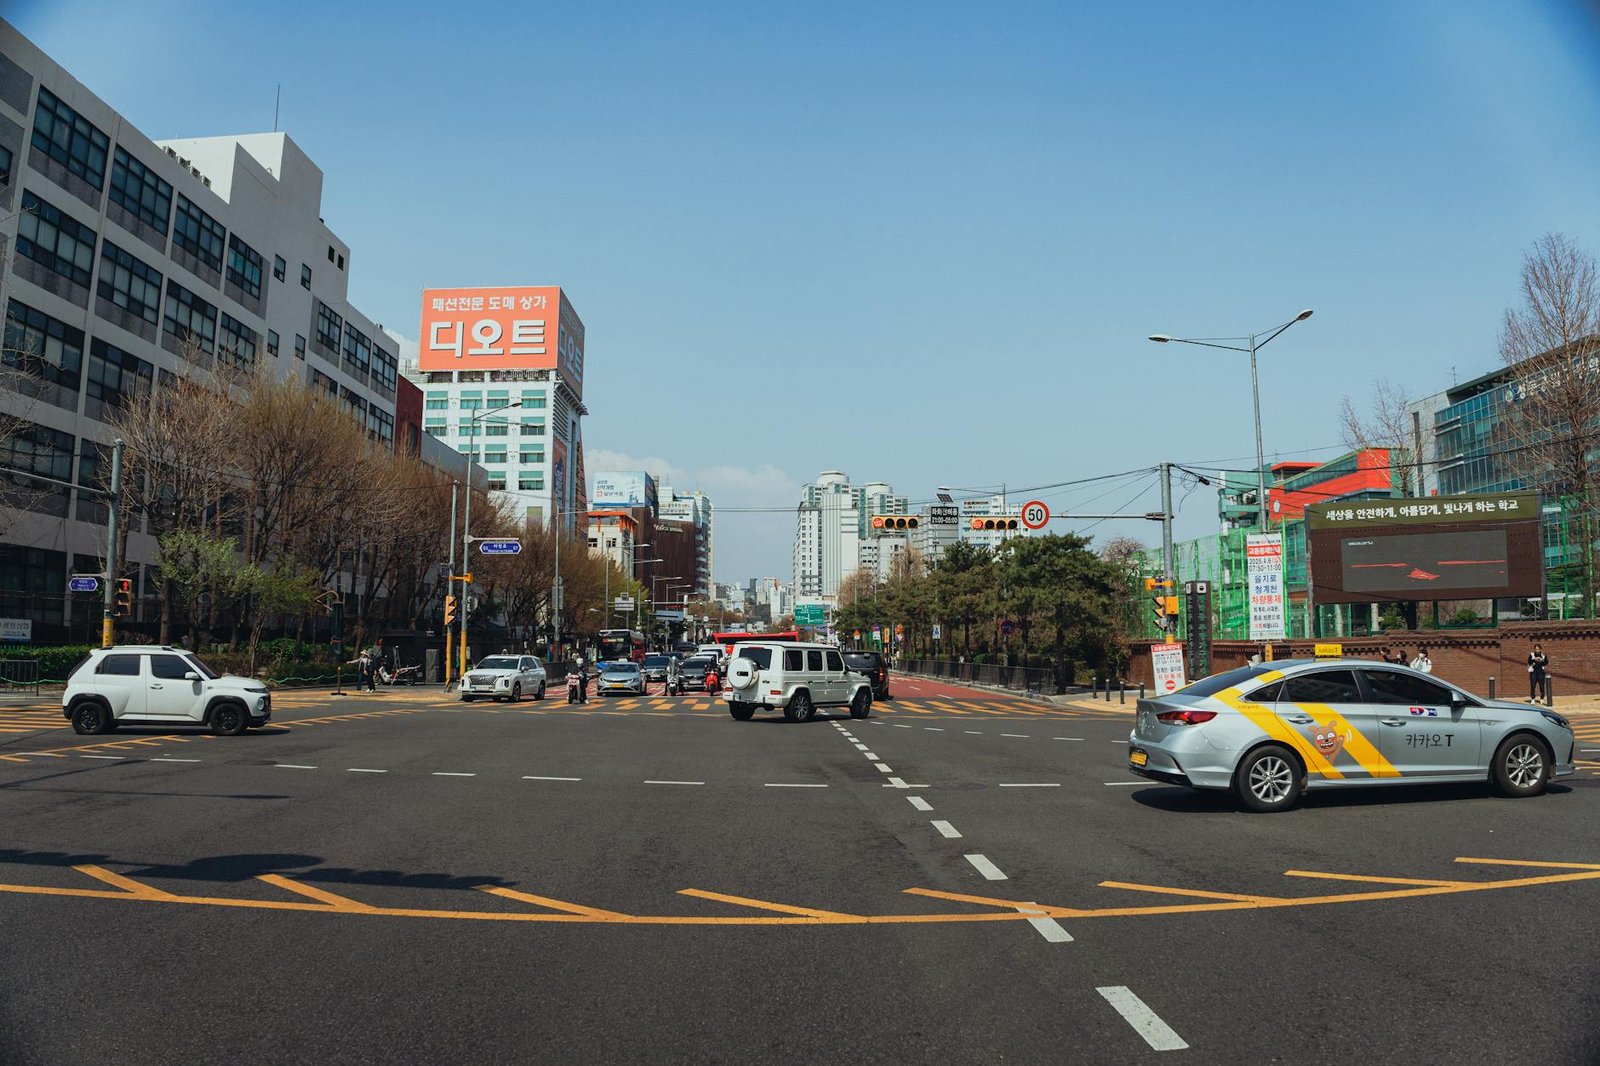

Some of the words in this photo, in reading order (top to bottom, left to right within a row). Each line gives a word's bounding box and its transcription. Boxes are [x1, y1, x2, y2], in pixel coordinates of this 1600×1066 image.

[432, 297, 484, 311] 패션전문
[488, 296, 515, 310] 도매
[519, 295, 547, 310] 상가
[430, 319, 546, 358] 디오트
[1028, 508, 1042, 524] 50
[1326, 509, 1354, 522] 세상을
[1356, 507, 1397, 519] 안전하게,
[1399, 504, 1440, 517] 아름답게,
[1444, 502, 1474, 514] 빛나게
[1476, 500, 1495, 513] 하는
[1498, 499, 1519, 511] 학교
[1254, 574, 1277, 583] 을지로
[1256, 584, 1278, 594] 청계천
[1252, 595, 1282, 604] 차량통제
